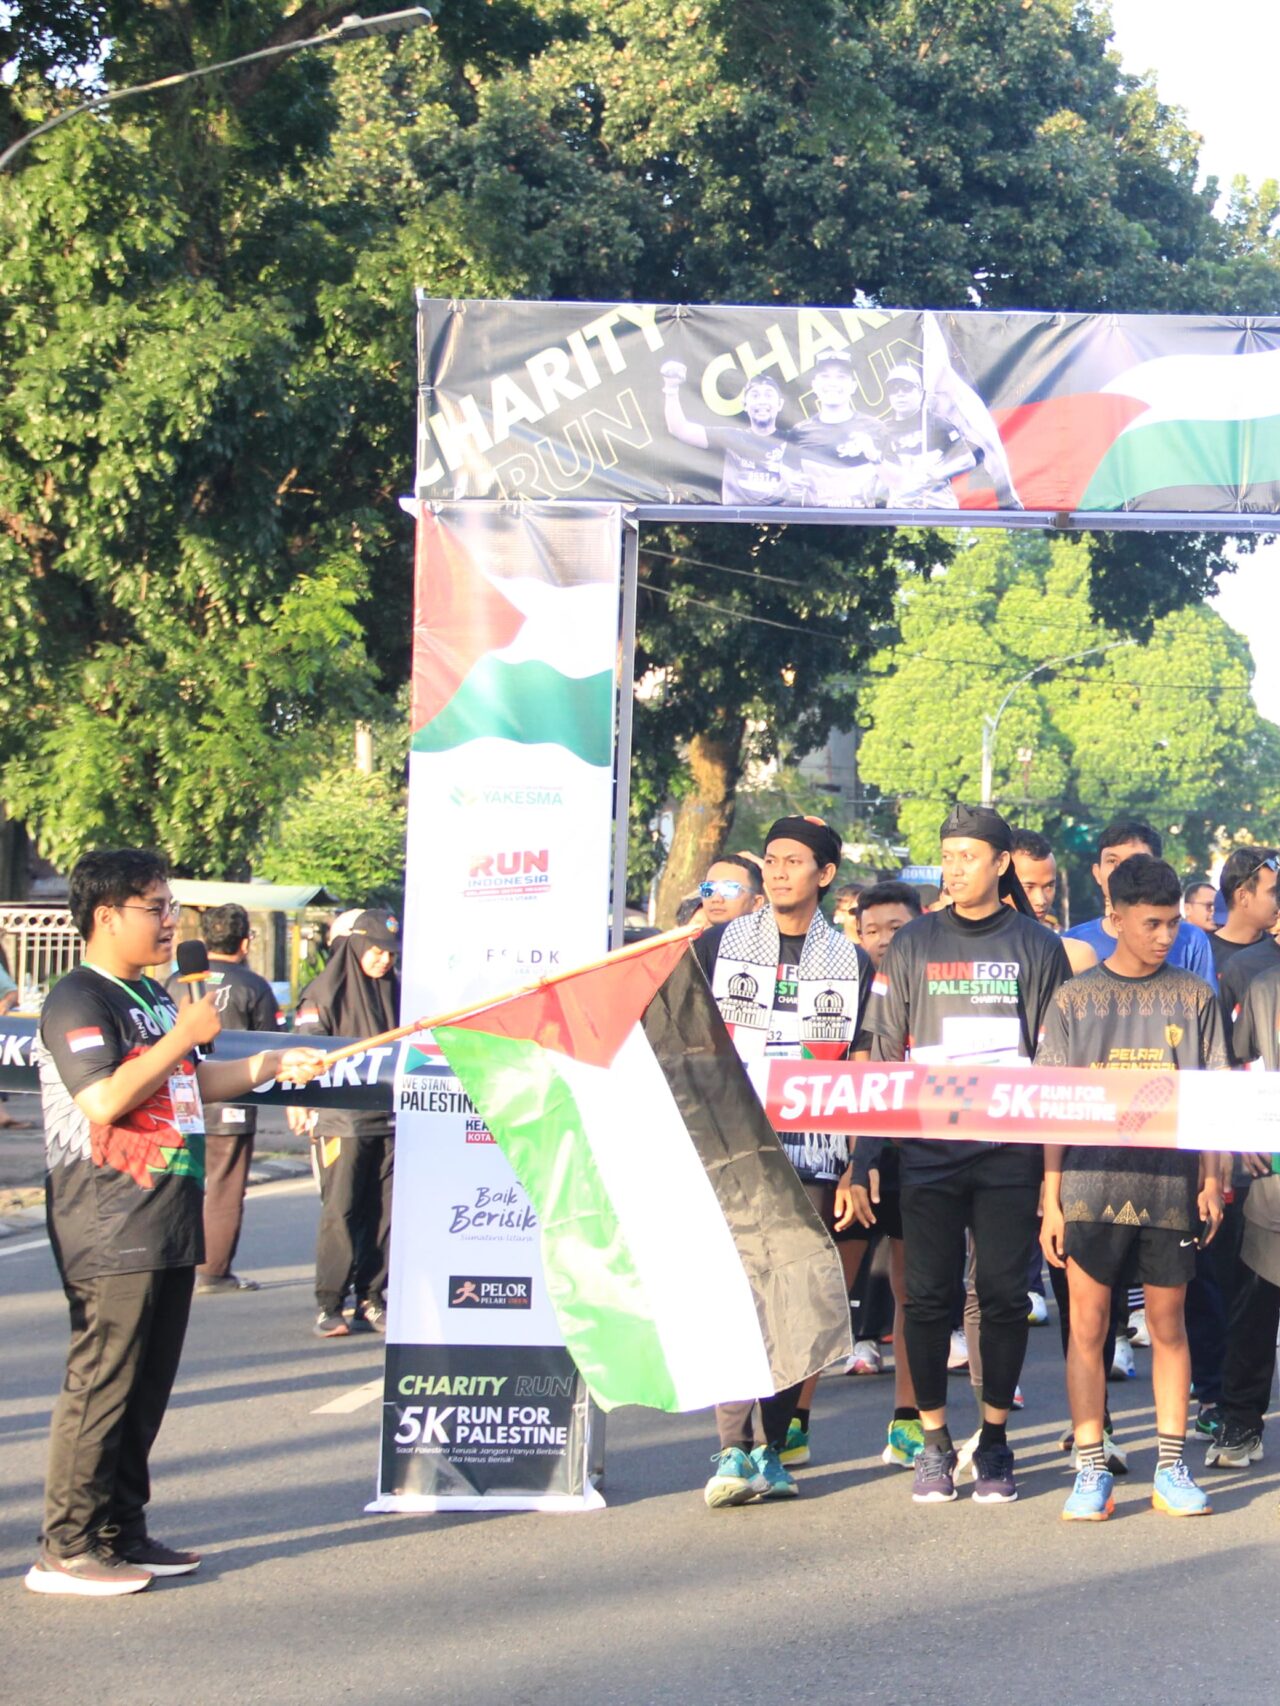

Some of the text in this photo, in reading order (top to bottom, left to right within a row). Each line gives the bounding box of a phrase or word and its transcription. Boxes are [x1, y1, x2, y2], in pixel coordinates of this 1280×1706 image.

[496, 388, 653, 500] RUN
[482, 791, 564, 807] YAKESMA
[468, 849, 549, 878] RUN
[467, 875, 549, 888] INDONESIA
[927, 962, 1017, 980] RUN FOR
[928, 981, 1018, 995] PALESTINE
[1108, 1048, 1164, 1061] PELARI
[400, 1091, 480, 1114] PALESTIN
[780, 1072, 913, 1119] START
[987, 1084, 1040, 1118] 5K
[1040, 1085, 1105, 1102] RUN FOR
[1040, 1101, 1117, 1121] PALESTINE
[467, 1133, 492, 1142] KOTA
[474, 1187, 518, 1208] Baik
[449, 1205, 537, 1233] Berisik
[481, 1283, 527, 1297] PELOR
[398, 1375, 573, 1397] CHARITY RUN
[393, 1406, 456, 1444] 5K
[457, 1407, 551, 1425] RUN FOR
[456, 1426, 567, 1445] PALESTINE
